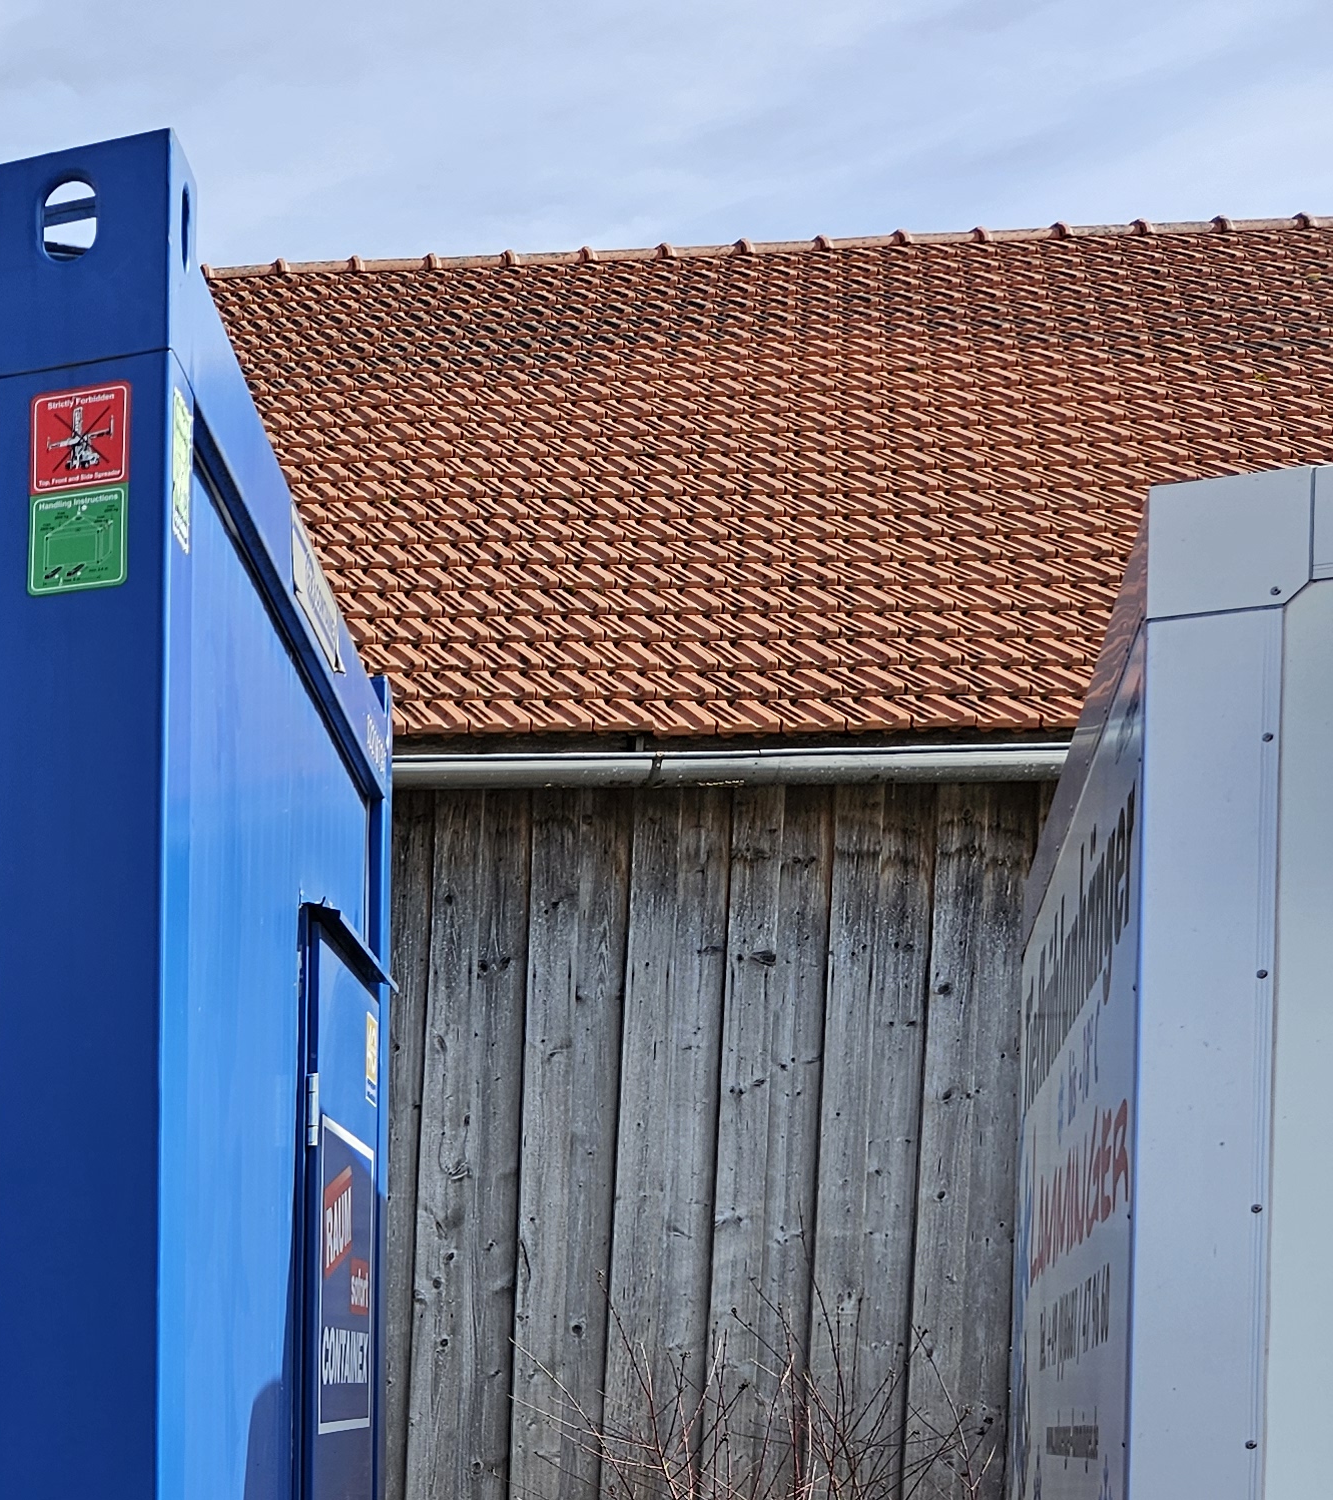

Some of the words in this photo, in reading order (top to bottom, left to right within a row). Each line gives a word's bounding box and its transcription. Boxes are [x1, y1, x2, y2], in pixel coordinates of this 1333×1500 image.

[47, 399, 74, 410] Strictly
[75, 393, 115, 405] Forbidden
[38, 499, 72, 511] Handling
[73, 493, 119, 506] Instructions
[1030, 1098, 1129, 1288] LAMMINGER
[325, 1186, 352, 1269] RAUM
[321, 1326, 369, 1386] CONTAINEX
